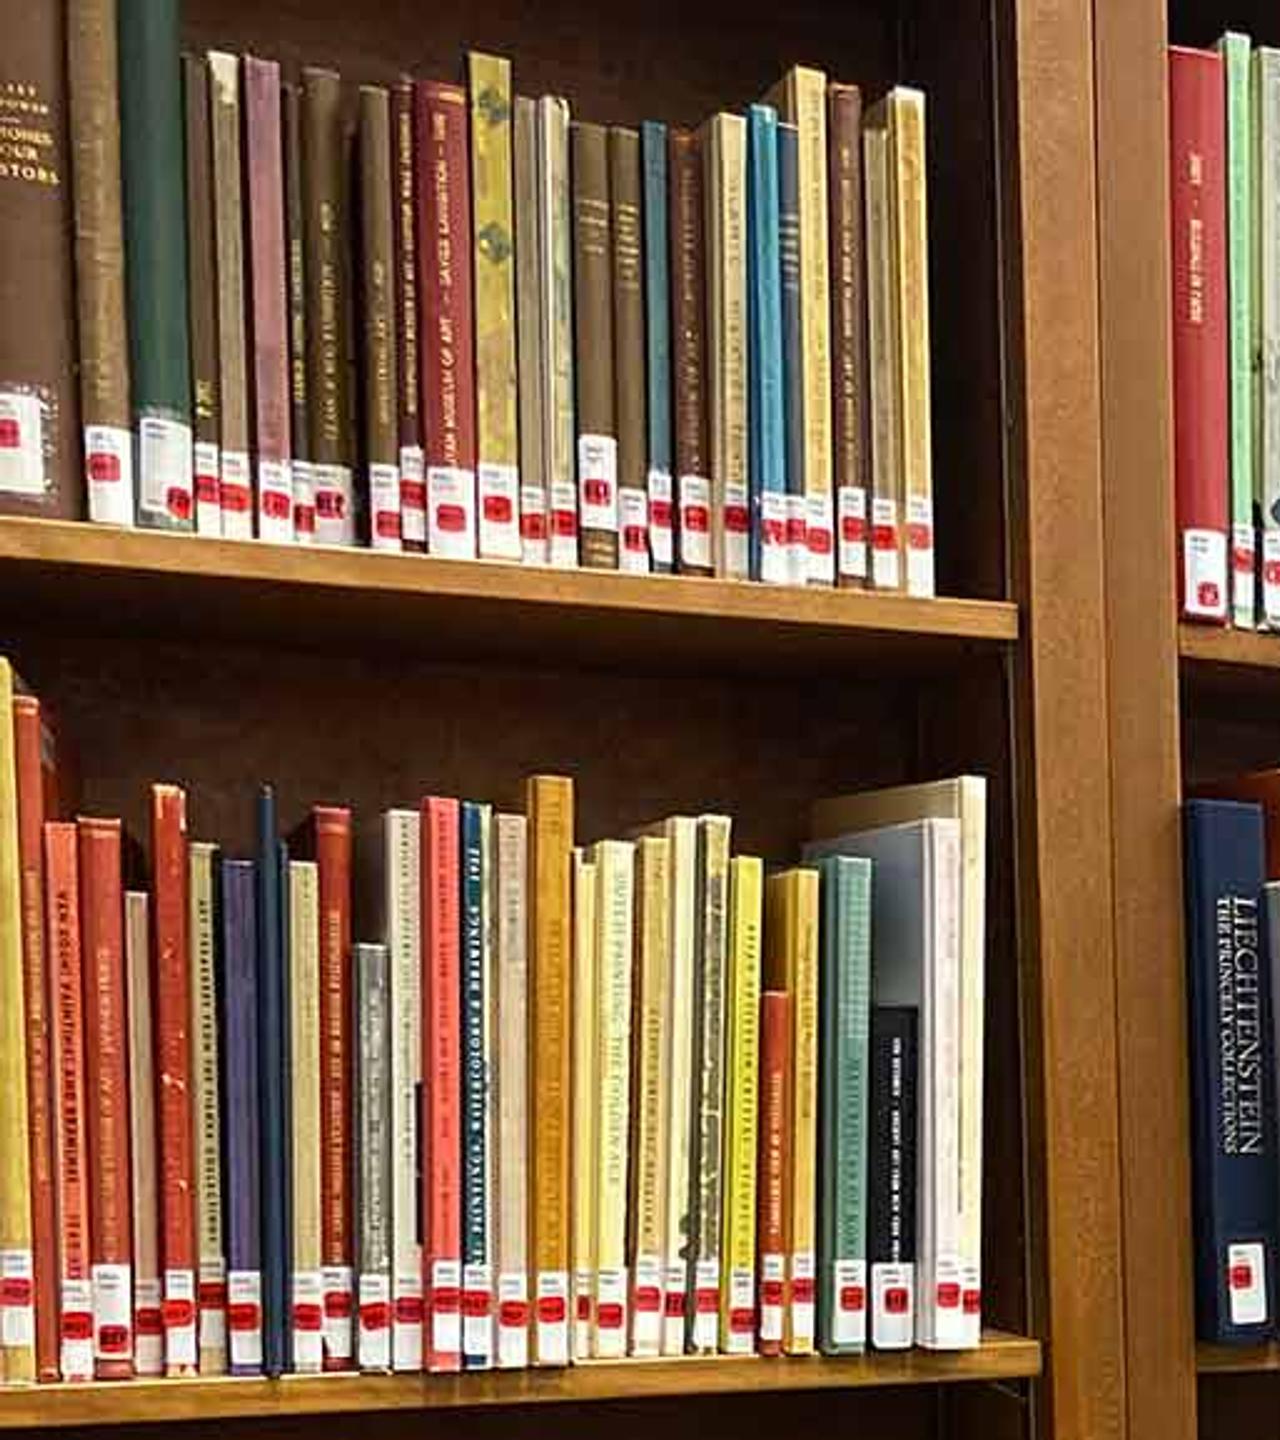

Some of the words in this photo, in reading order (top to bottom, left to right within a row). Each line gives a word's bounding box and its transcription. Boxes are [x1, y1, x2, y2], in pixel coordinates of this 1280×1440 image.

[1216, 897, 1232, 933] THE
[1218, 938, 1234, 1024] PRINCELY
[1234, 896, 1262, 1153] LIECHTENSTEIN
[1221, 1029, 1237, 1153] COLLECTIONS
